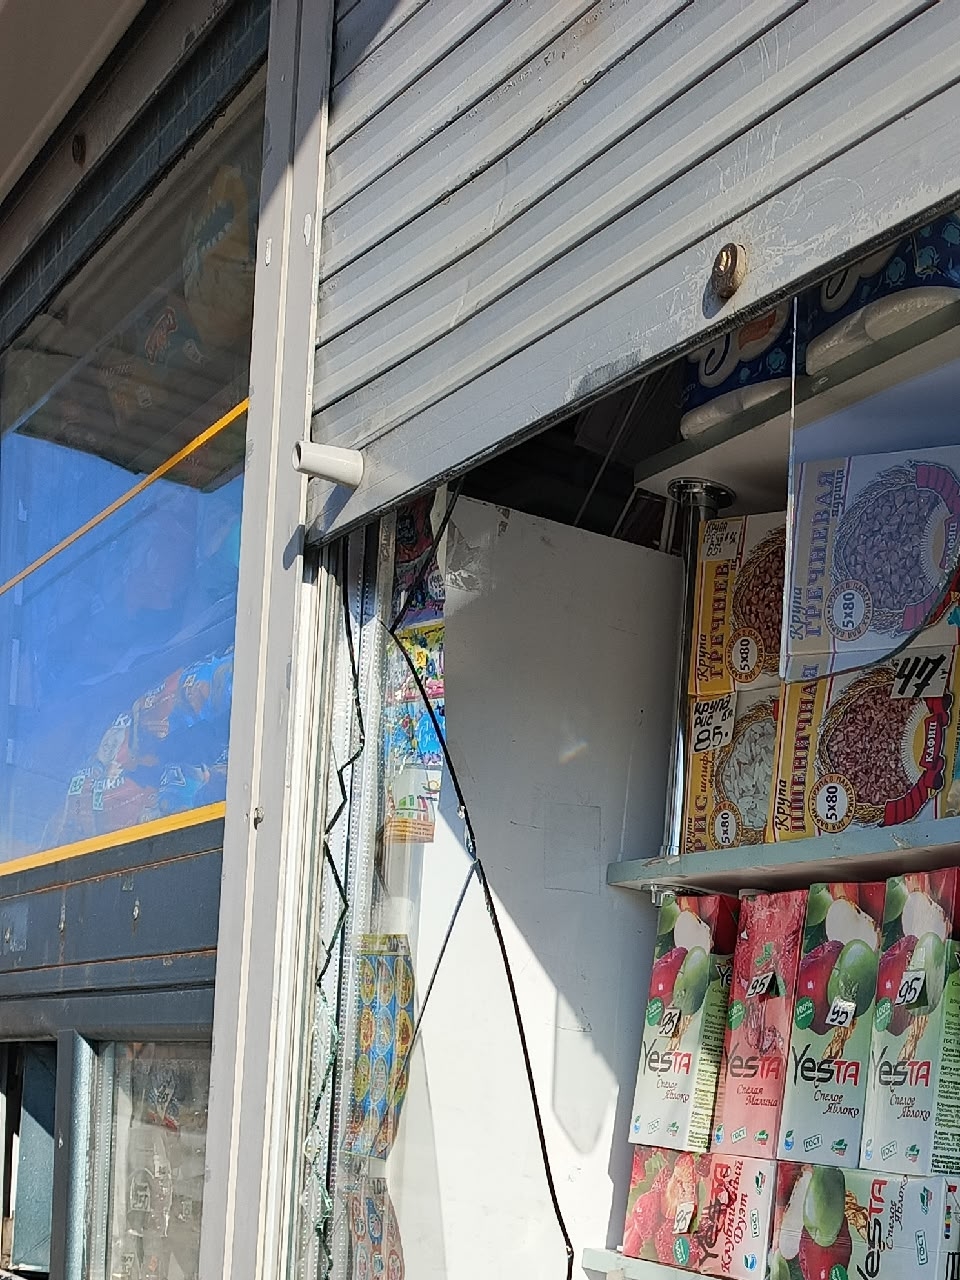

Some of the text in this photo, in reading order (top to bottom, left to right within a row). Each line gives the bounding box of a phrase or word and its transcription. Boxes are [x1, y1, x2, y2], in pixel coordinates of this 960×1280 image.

[804, 470, 836, 639] ГРЕЧНЕВАЯ
[710, 562, 730, 680] ГРЕЧНЕВ
[789, 587, 804, 641] Крупа
[697, 633, 709, 682] Крупа
[693, 795, 708, 853] РИС
[775, 778, 790, 832] Крупа
[750, 976, 769, 997] 95
[898, 977, 922, 1005] 95
[814, 1090, 844, 1102] Спелое
[823, 1102, 861, 1119] Яблоко
[897, 1107, 931, 1122] Яблоко
[805, 1137, 821, 1149] ГОСТ
[721, 1159, 743, 1274] Клубниный
[734, 1193, 748, 1245] Дуэт
[751, 1212, 760, 1239] ГОСТ
[885, 1199, 897, 1250] Спелое
[894, 1174, 909, 1232] Яблоко
[917, 1233, 927, 1263] ГОСТ
